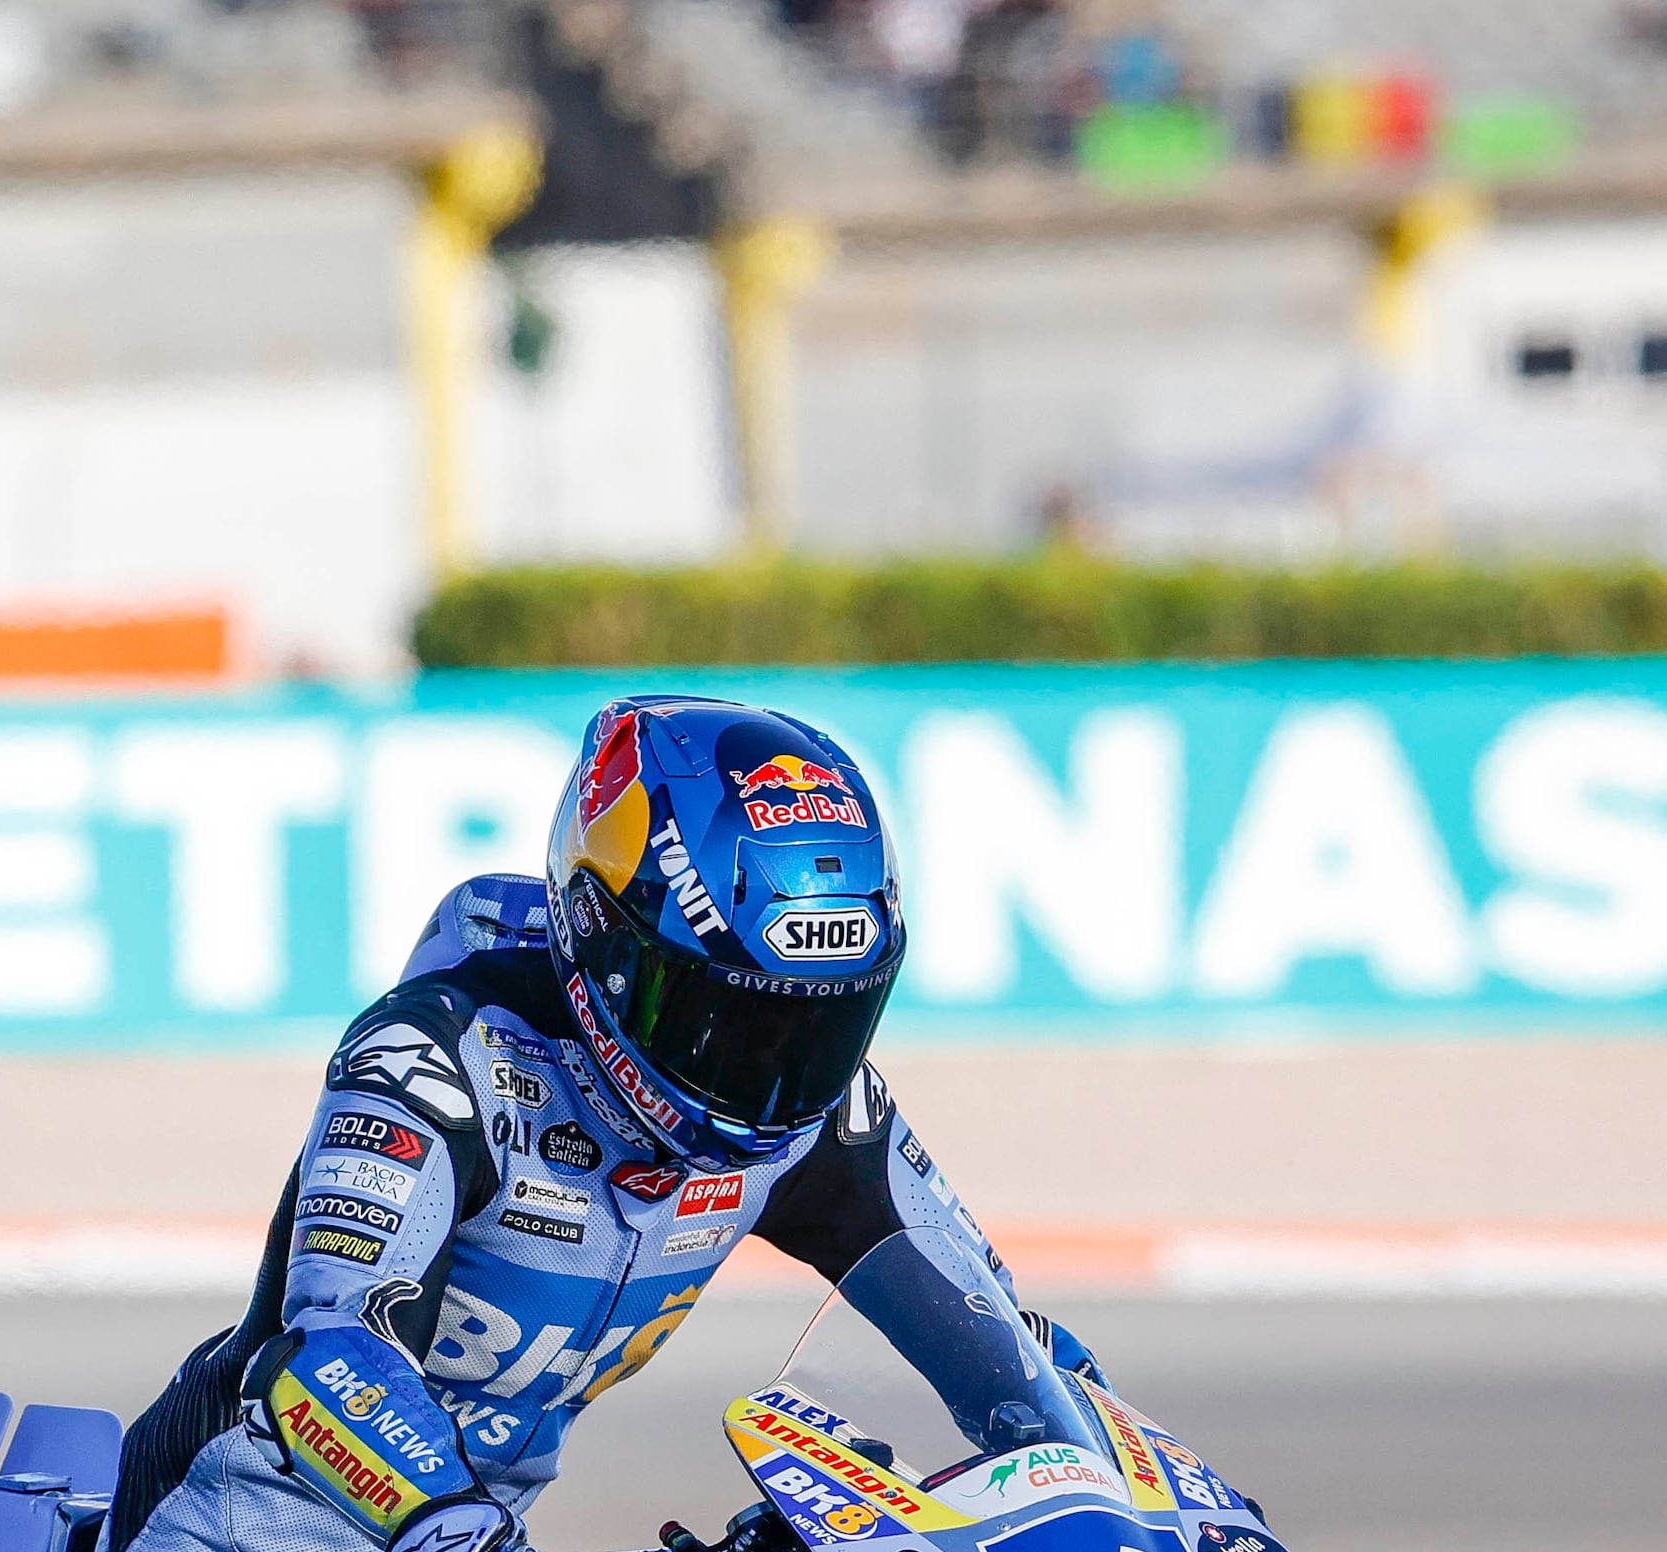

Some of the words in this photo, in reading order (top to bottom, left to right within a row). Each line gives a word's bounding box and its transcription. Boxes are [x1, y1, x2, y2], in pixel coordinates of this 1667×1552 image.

[744, 790, 813, 832] Red
[813, 789, 867, 829] Bull
[650, 818, 731, 937] TONIT
[582, 870, 609, 933] VERTICAL
[785, 918, 866, 951] SHOEI
[727, 972, 794, 996] GIVES
[805, 981, 844, 997] YOU
[568, 973, 621, 1066] Red
[609, 1053, 682, 1135] Bull
[325, 1135, 381, 1151] RIDERS
[328, 1115, 389, 1138] BOLD
[547, 1132, 594, 1156] Estrella
[546, 1144, 590, 1169] Galicia
[684, 1175, 739, 1213] ASPIRA
[296, 1198, 399, 1235] momoven
[503, 1213, 542, 1232] POLO
[543, 1222, 579, 1240] CLUB
[304, 1230, 383, 1263] AKRAPOVIČ
[314, 1356, 386, 1421] BK8
[371, 1414, 447, 1475] NEWS
[760, 1389, 849, 1436] ALEX
[278, 1397, 404, 1515] Antangin
[743, 1409, 924, 1517] Antangin
[1026, 1445, 1082, 1472] AUS
[1026, 1459, 1125, 1496] GLOBAL
[763, 1462, 881, 1541] BK8
[788, 1512, 839, 1547] NEWS
